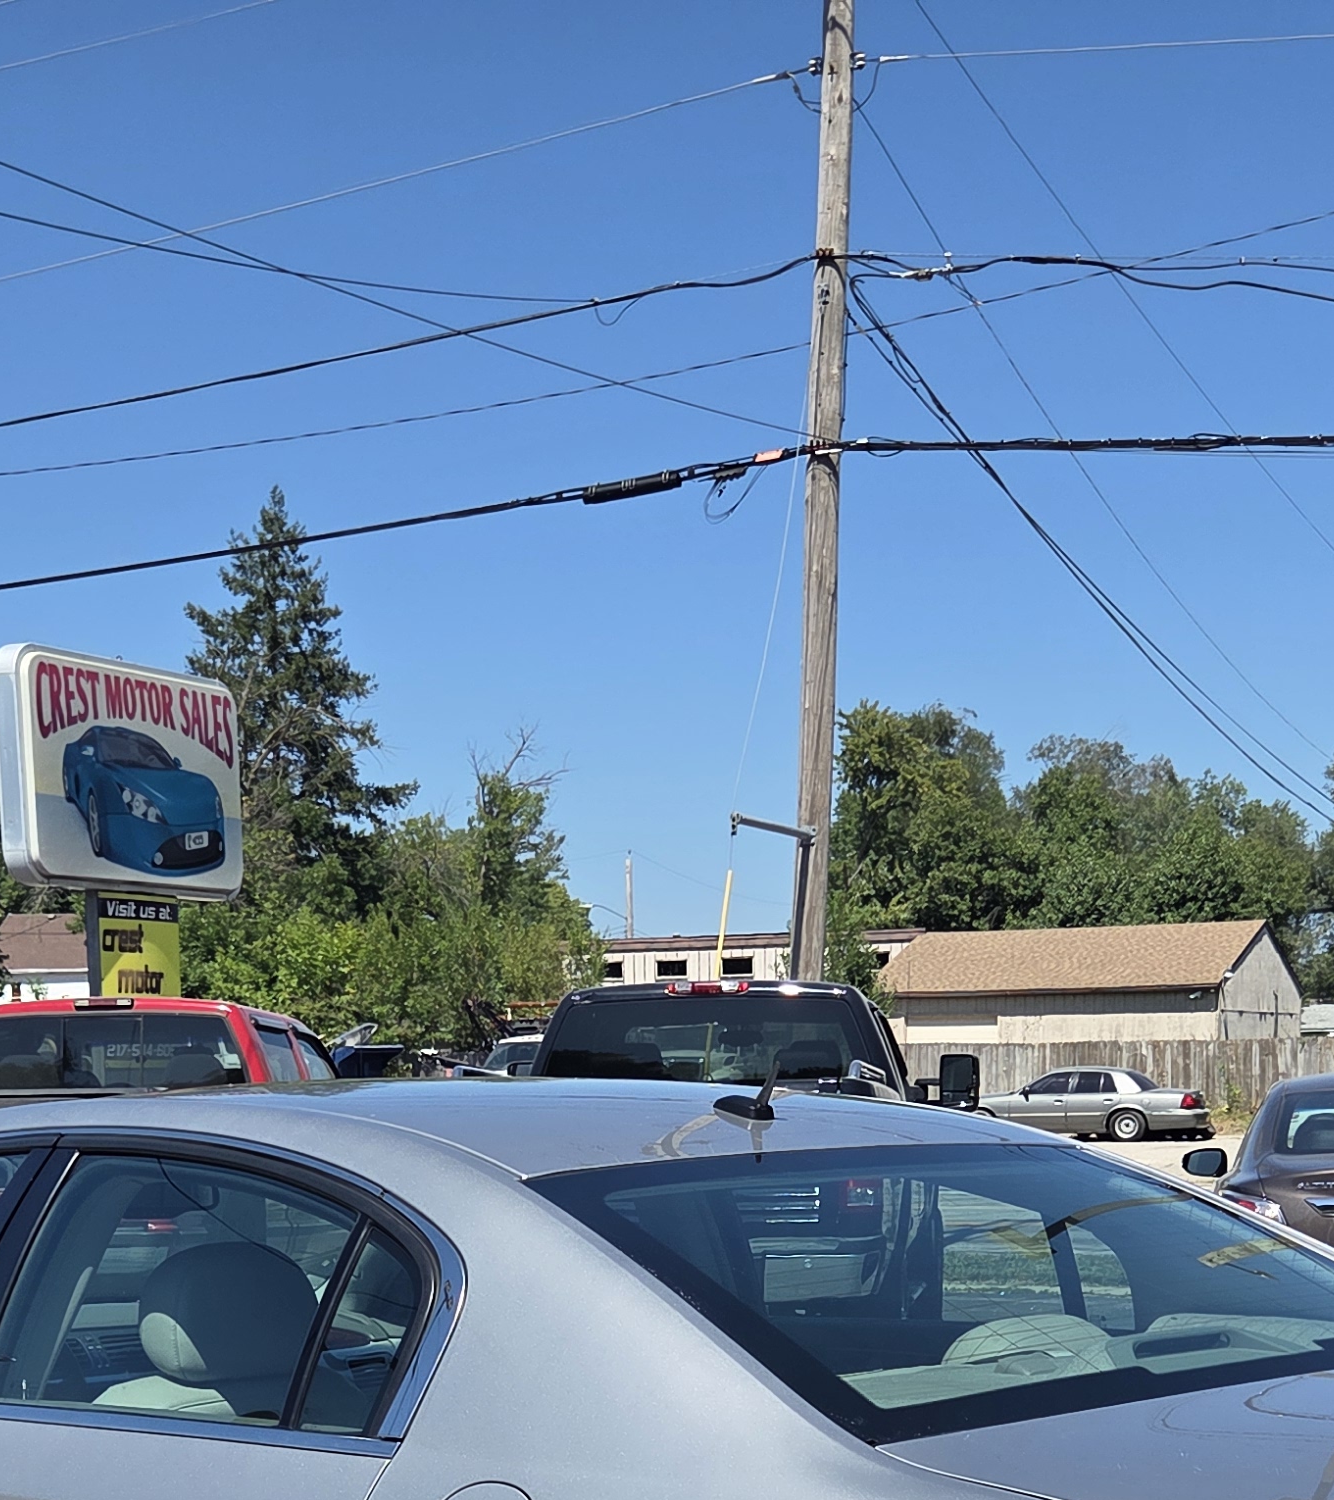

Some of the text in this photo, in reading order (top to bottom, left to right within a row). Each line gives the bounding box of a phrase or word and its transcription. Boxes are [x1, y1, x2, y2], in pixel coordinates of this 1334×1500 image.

[36, 661, 234, 770] CREST MOTOR SALES
[107, 900, 136, 917] Visit
[139, 905, 156, 920] us
[102, 923, 144, 953] crest
[117, 964, 164, 994] motor
